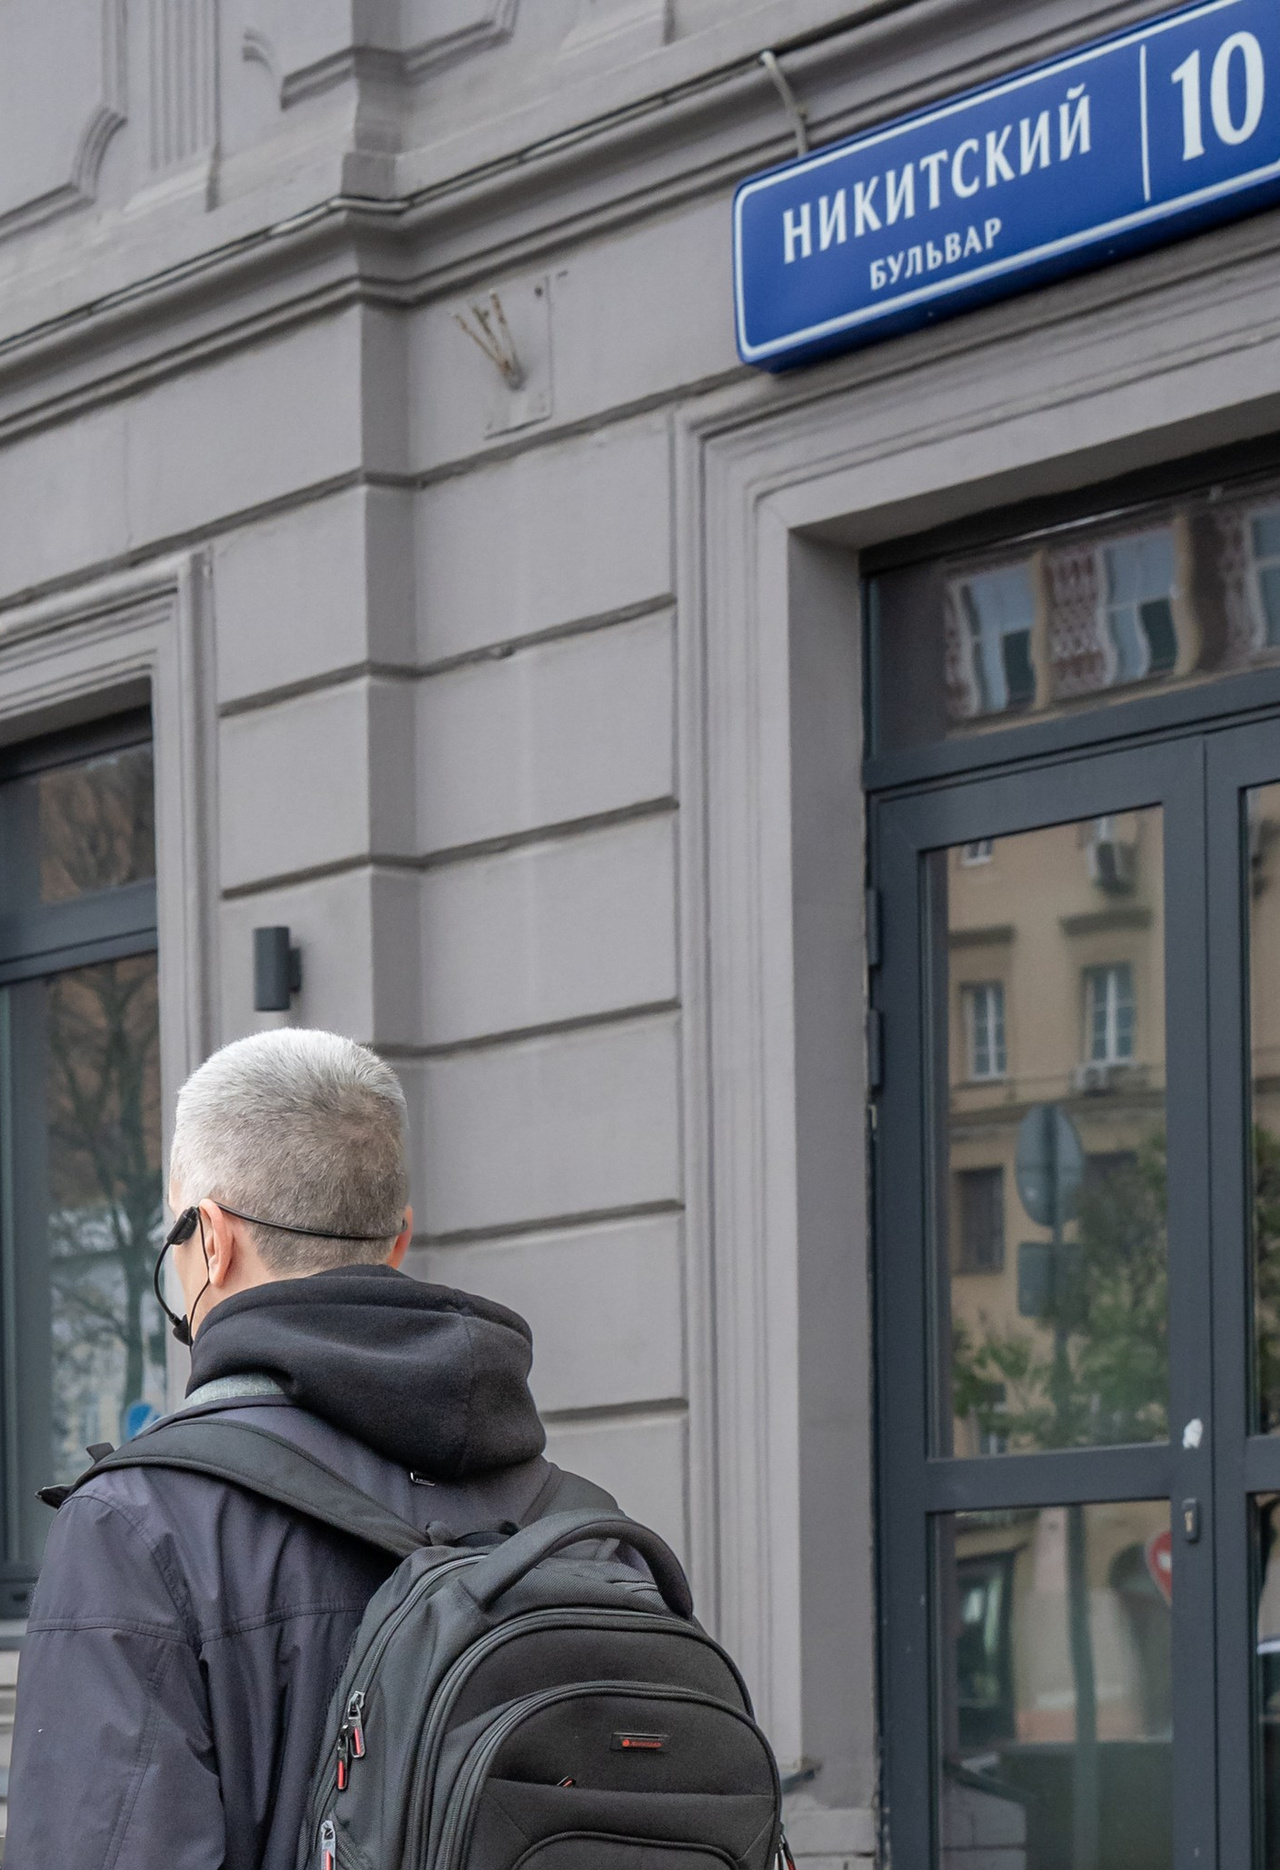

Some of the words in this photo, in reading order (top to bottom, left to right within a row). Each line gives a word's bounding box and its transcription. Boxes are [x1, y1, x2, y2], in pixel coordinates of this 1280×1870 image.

[1170, 31, 1265, 161] 10
[782, 83, 1092, 264] НИКИТСКИЙ
[869, 217, 1002, 291] БУЛЬВАР
